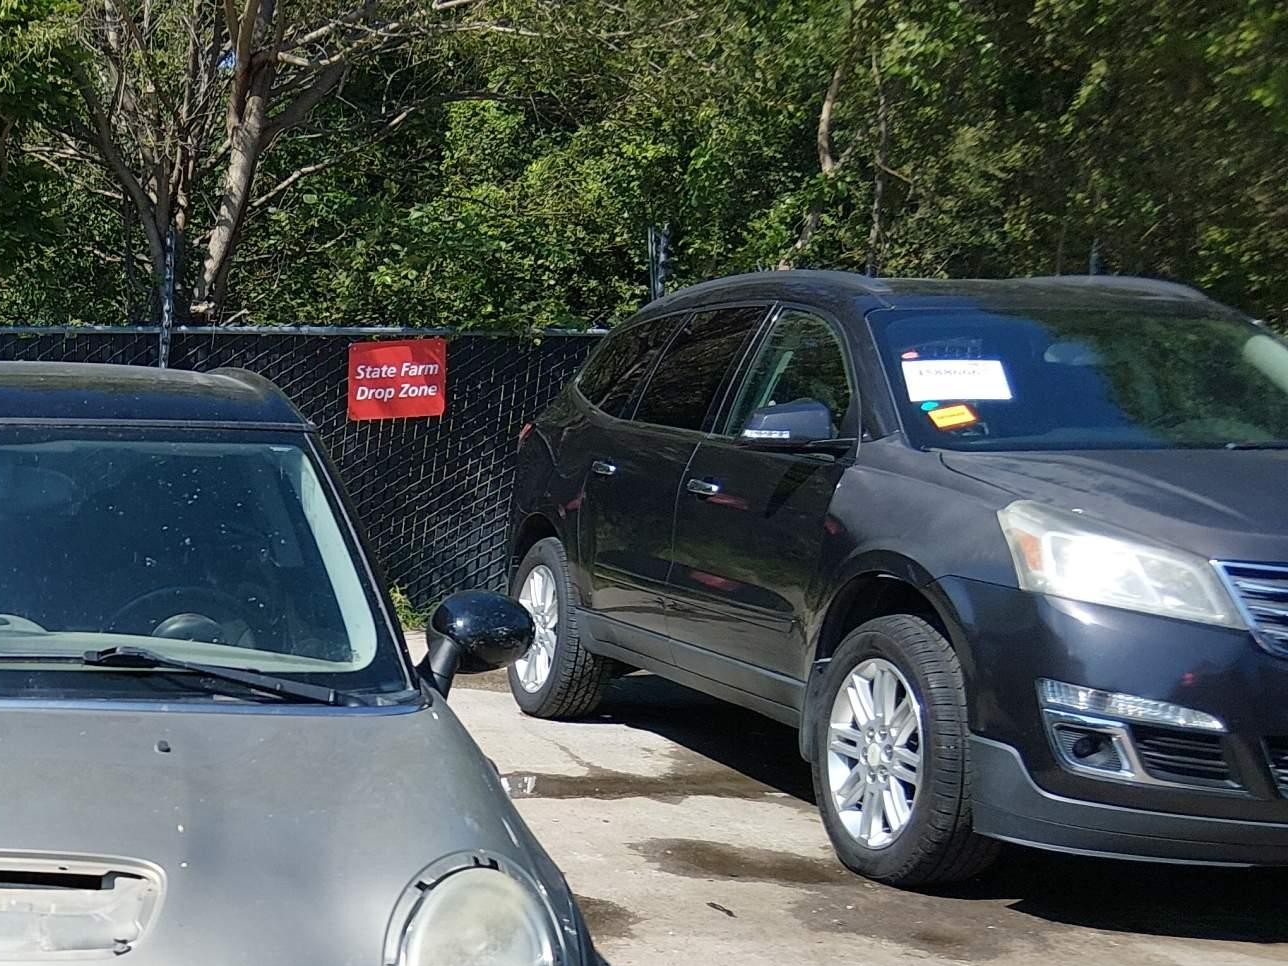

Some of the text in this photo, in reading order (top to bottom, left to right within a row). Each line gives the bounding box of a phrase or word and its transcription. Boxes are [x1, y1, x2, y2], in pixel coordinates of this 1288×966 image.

[355, 362, 440, 379] State Farm
[356, 383, 438, 402] Drop Zone
